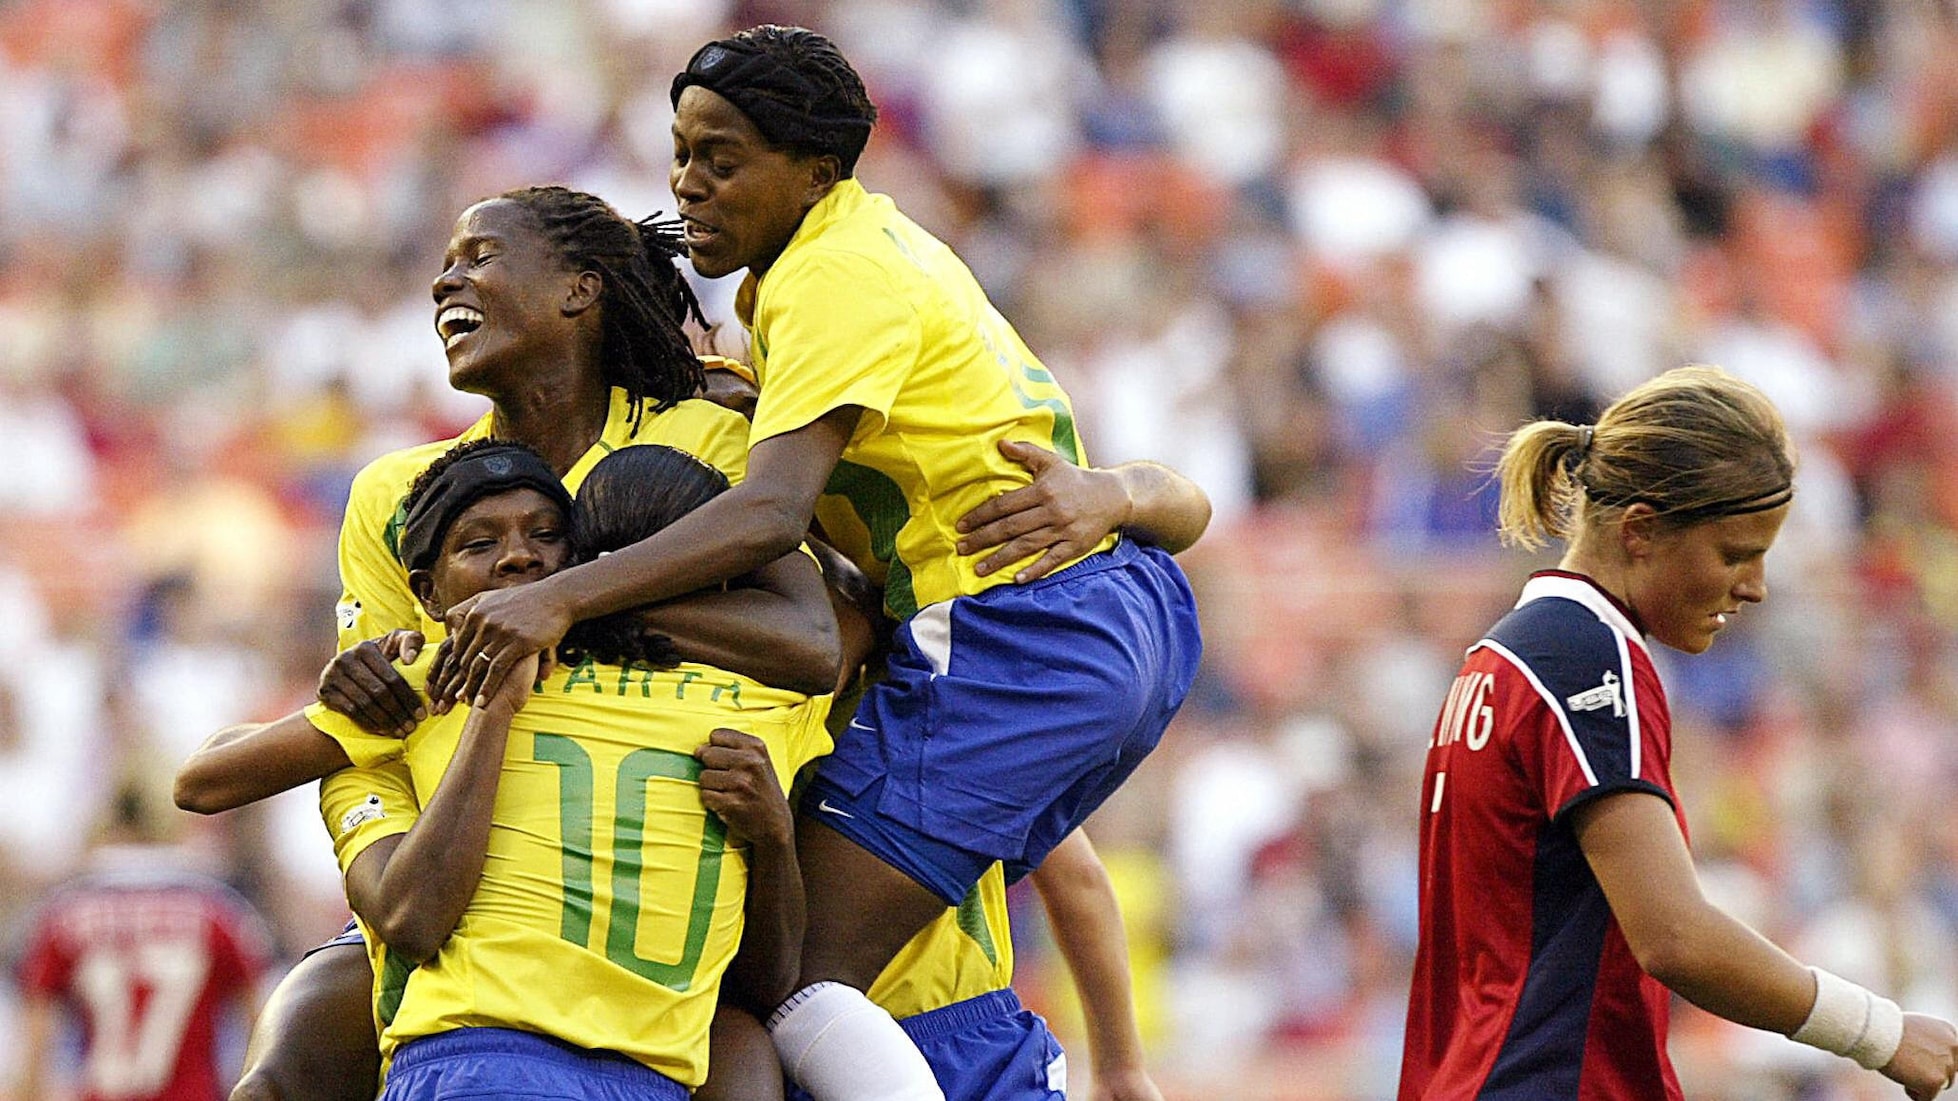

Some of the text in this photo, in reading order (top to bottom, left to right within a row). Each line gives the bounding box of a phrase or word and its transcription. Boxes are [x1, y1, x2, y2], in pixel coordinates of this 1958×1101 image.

[533, 656, 744, 710] ARTA
[534, 732, 728, 993] 10
[77, 944, 214, 1093] 17
